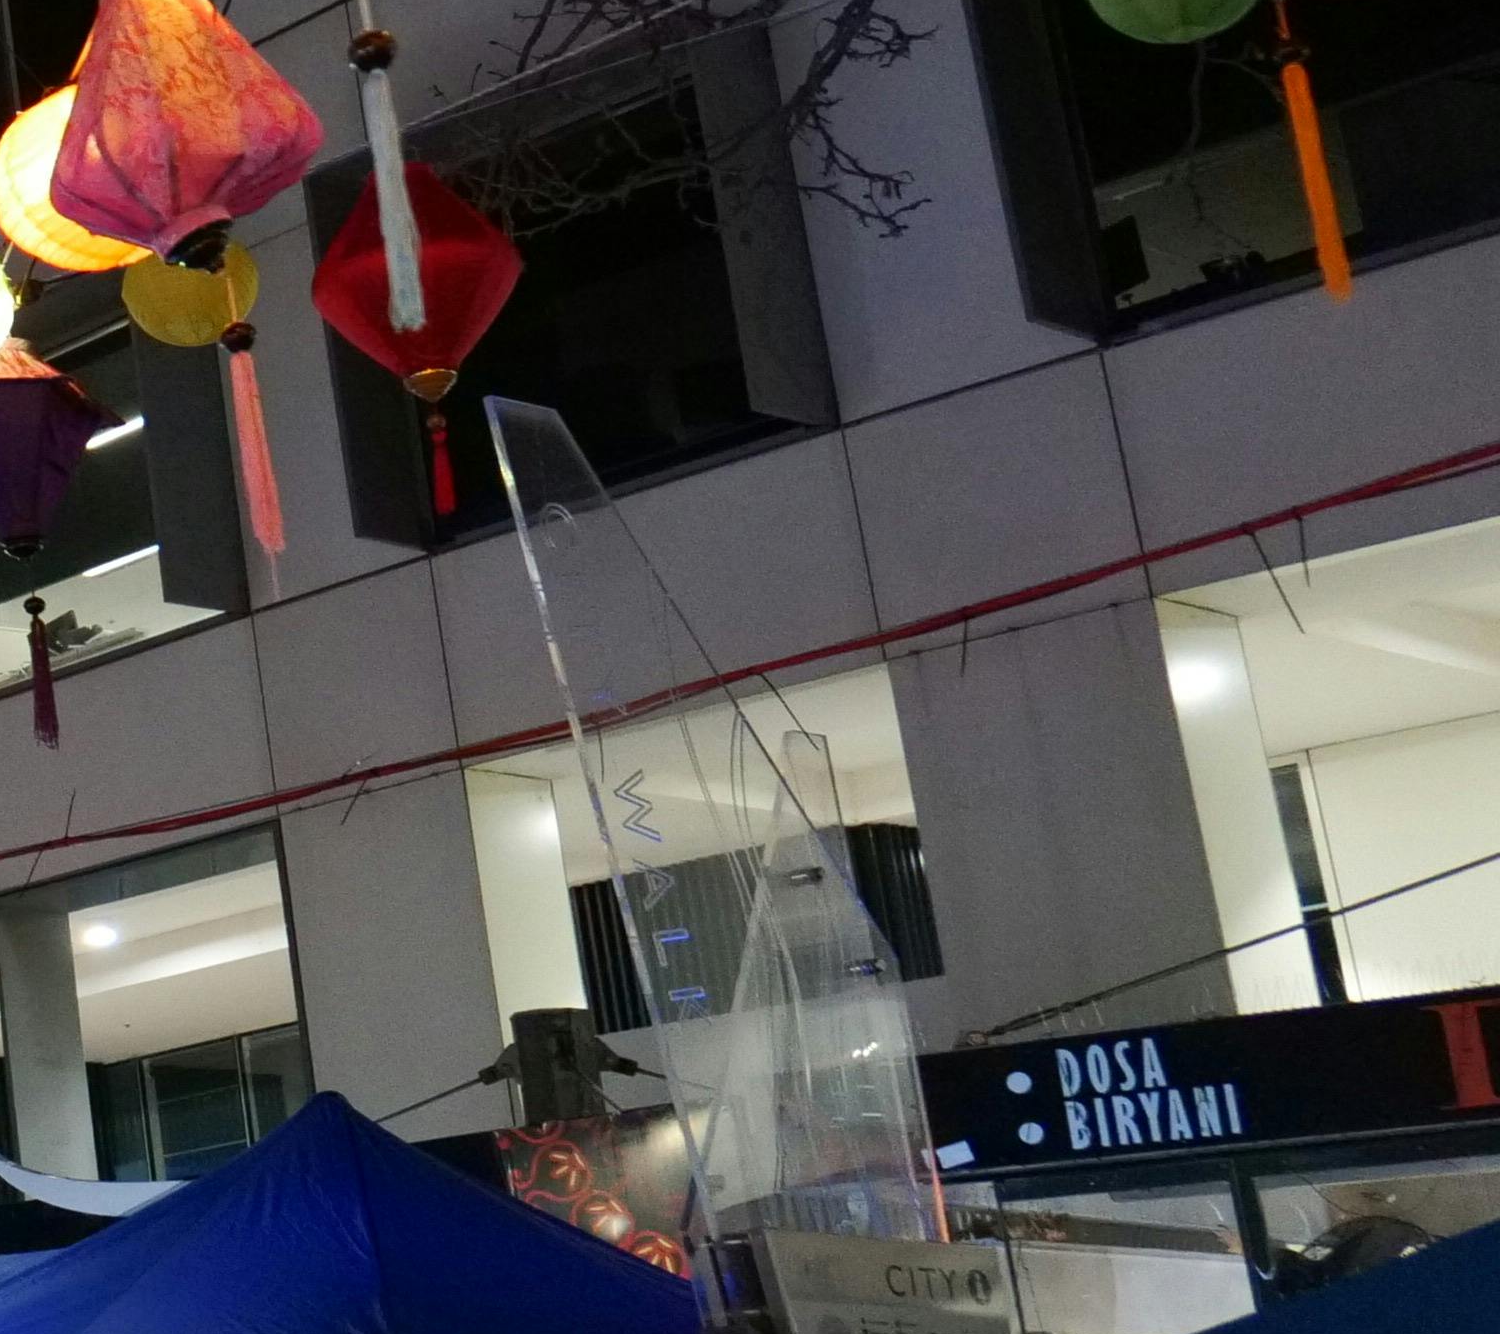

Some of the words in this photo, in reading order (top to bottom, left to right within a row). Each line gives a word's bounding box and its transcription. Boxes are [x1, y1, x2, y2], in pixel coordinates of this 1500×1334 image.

[611, 768, 713, 1026] WALK
[1056, 1037, 1167, 1098] DOSA
[1062, 1082, 1245, 1151] BIRYANI
[884, 1264, 957, 1300] CITY
